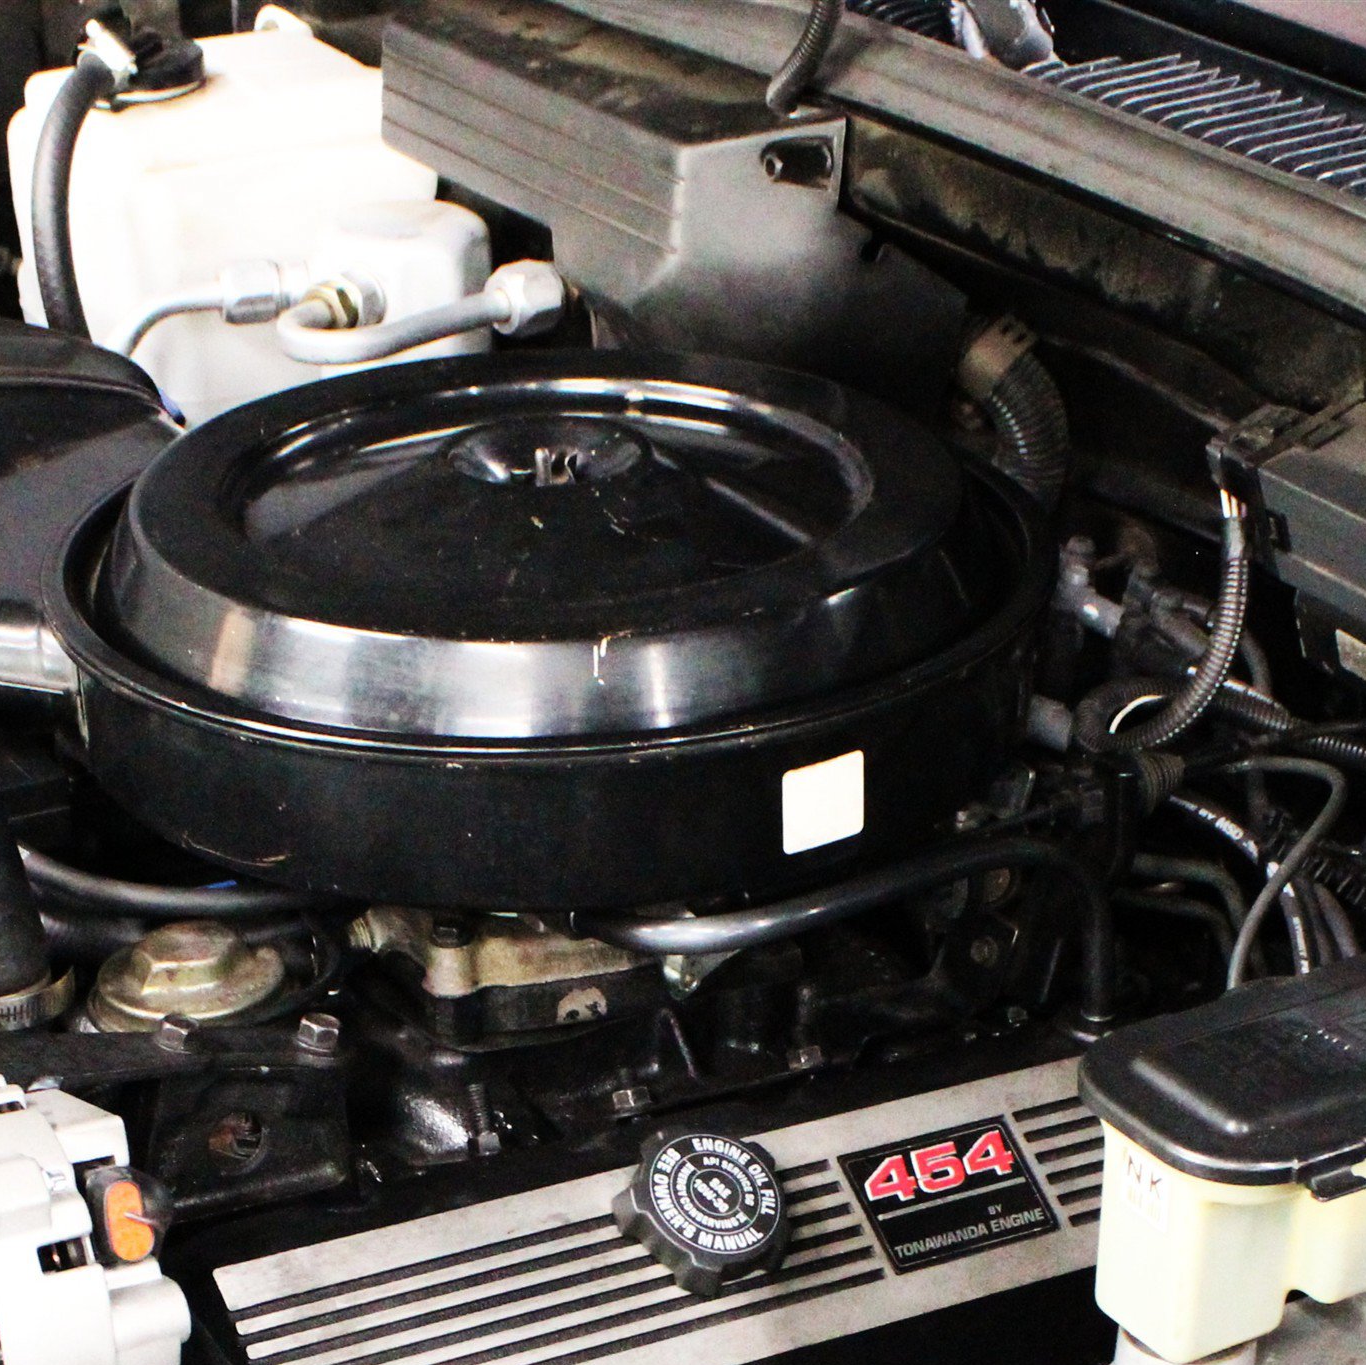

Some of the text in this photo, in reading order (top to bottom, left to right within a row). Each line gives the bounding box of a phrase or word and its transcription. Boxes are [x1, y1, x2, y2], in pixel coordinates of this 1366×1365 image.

[691, 1137, 776, 1215] ENGINE OIL FILL
[702, 1156, 720, 1167] API
[720, 1159, 754, 1192] SERVICE
[863, 1129, 1015, 1202] 454
[653, 1147, 765, 1250] SEE OWNER'S MANUAL
[679, 1196, 740, 1229] CONSERVING
[693, 1177, 733, 1213] SAE 10W-30
[987, 1203, 1003, 1216] BY
[893, 1207, 1045, 1260] TONAWANDA ENGINE
